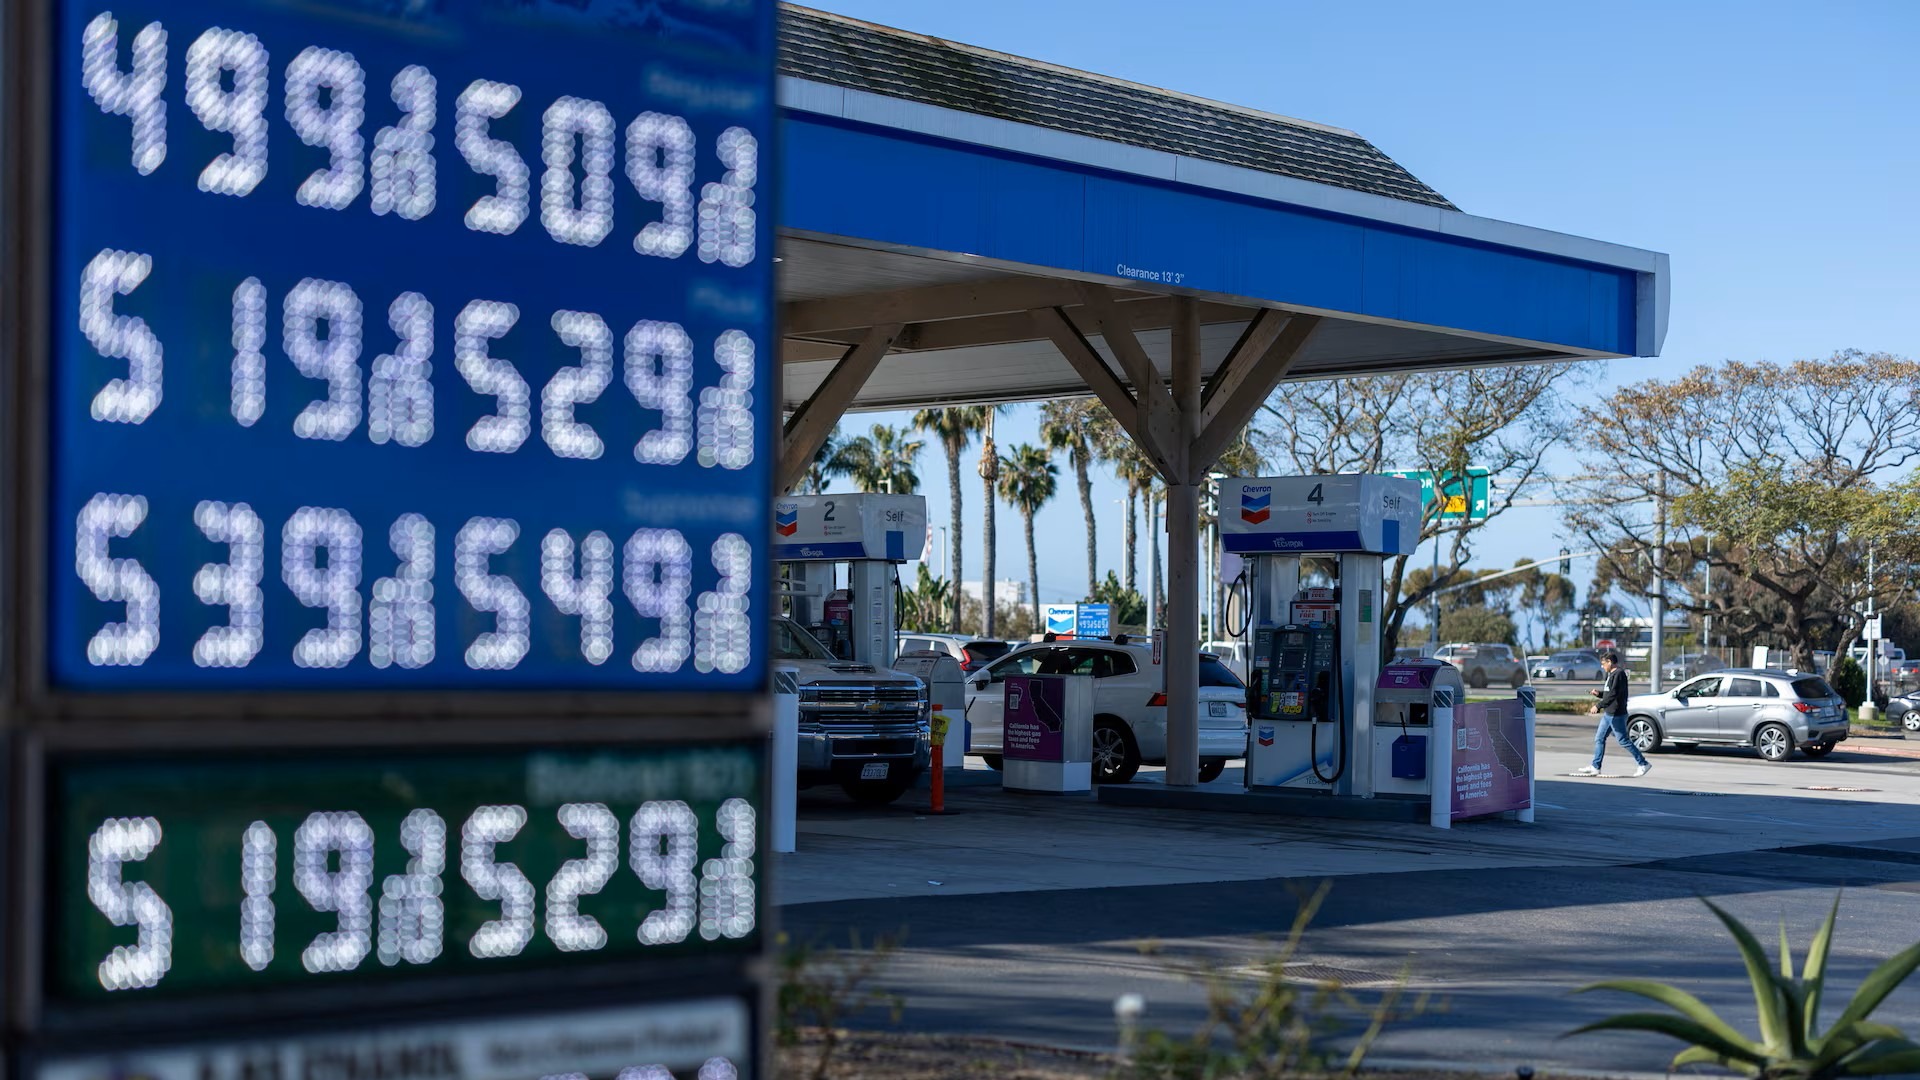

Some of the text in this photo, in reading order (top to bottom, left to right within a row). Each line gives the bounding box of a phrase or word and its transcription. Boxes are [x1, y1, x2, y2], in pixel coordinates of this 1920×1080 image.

[1117, 264, 1159, 280] Clearance
[1242, 485, 1272, 493] Chevron
[1307, 483, 1324, 506] 4
[1383, 495, 1400, 510] Self
[824, 501, 835, 521] 2
[886, 511, 904, 522] Self
[1273, 540, 1304, 549] TECHRON
[1457, 764, 1480, 773] California
[1464, 773, 1482, 782] highest
[1483, 772, 1493, 780] gas
[1465, 790, 1488, 799] America.
